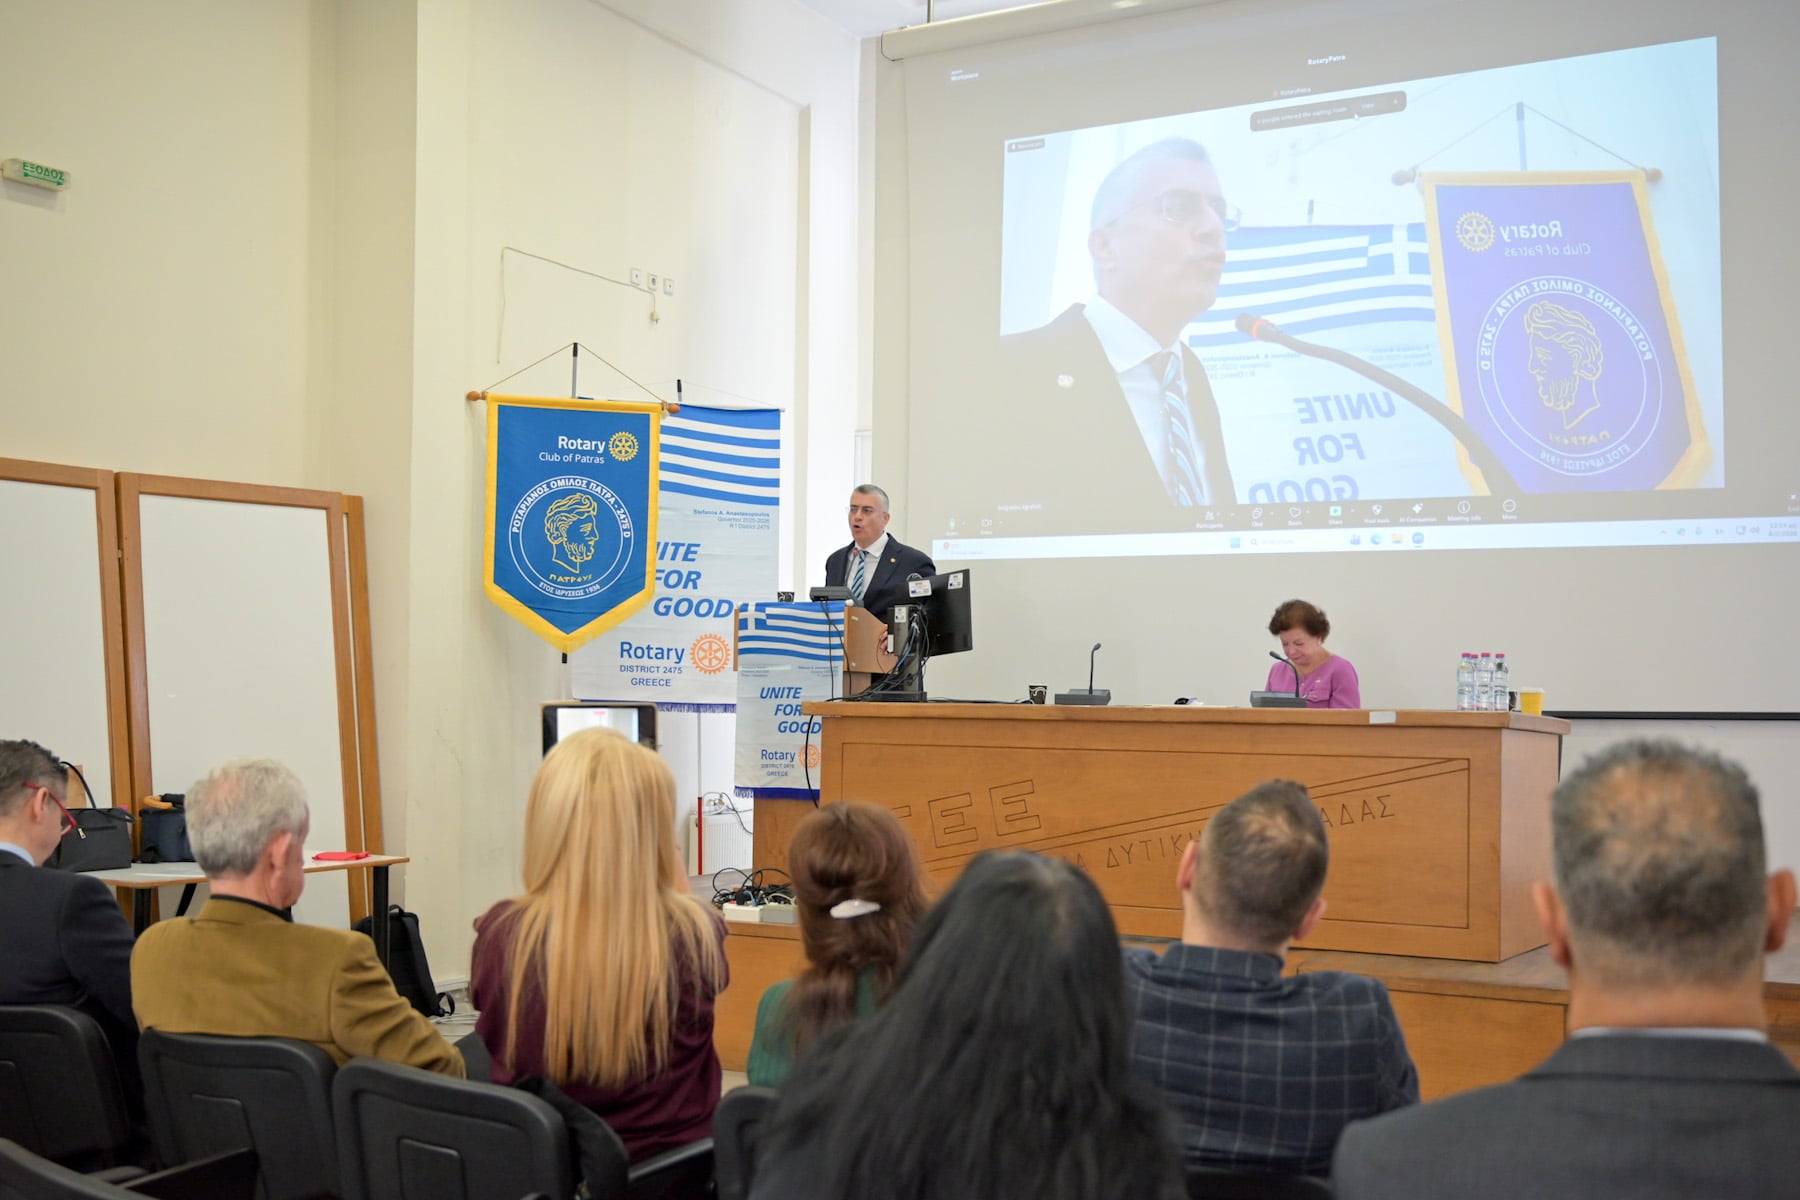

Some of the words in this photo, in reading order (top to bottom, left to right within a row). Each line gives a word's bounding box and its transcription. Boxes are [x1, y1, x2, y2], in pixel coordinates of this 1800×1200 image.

[22, 161, 65, 181] ΕΞΟΔΟΣ
[558, 435, 606, 454] Rotary
[538, 451, 561, 462] Club
[562, 453, 574, 463] of
[574, 454, 605, 464] Patras
[512, 483, 550, 533] ΡΟΤΑΡΙΑΝΟΣ
[550, 479, 588, 489] ΟΜΙΛΟΣ
[589, 482, 616, 505] ΠΑΤΡΑ
[656, 541, 701, 562] ITE
[653, 596, 734, 618] GOOD
[620, 641, 685, 664] Rotary
[619, 664, 660, 674] DISTRICT
[663, 666, 683, 674] 2475
[630, 677, 671, 687] GREECE
[760, 687, 802, 699] UNITE
[774, 703, 802, 716] FOR
[778, 721, 822, 734] GOOD
[761, 749, 796, 763] Rotary
[891, 778, 1042, 849] ΕΕ
[1106, 829, 1201, 869] ΔΥΤΙΚ
[1319, 794, 1396, 828] ΑΔΑΣ
